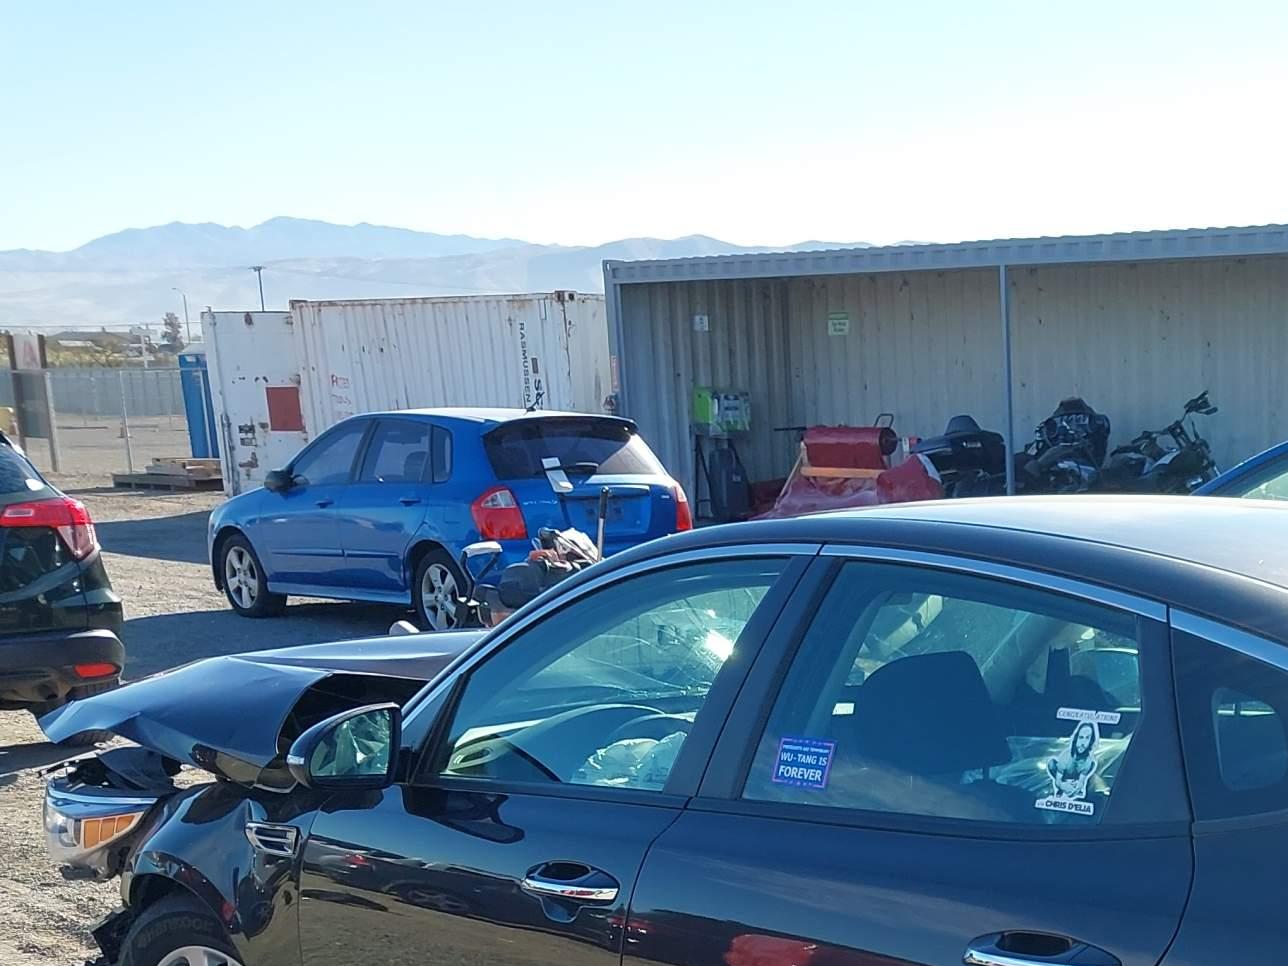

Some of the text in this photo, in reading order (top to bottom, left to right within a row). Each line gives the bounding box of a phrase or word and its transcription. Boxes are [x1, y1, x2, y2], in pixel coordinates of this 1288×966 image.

[519, 322, 531, 403] RASMUSSEN
[780, 751, 828, 766] WU-TANG IS
[778, 765, 822, 781] FOREVER
[1045, 800, 1067, 809] CHRIS
